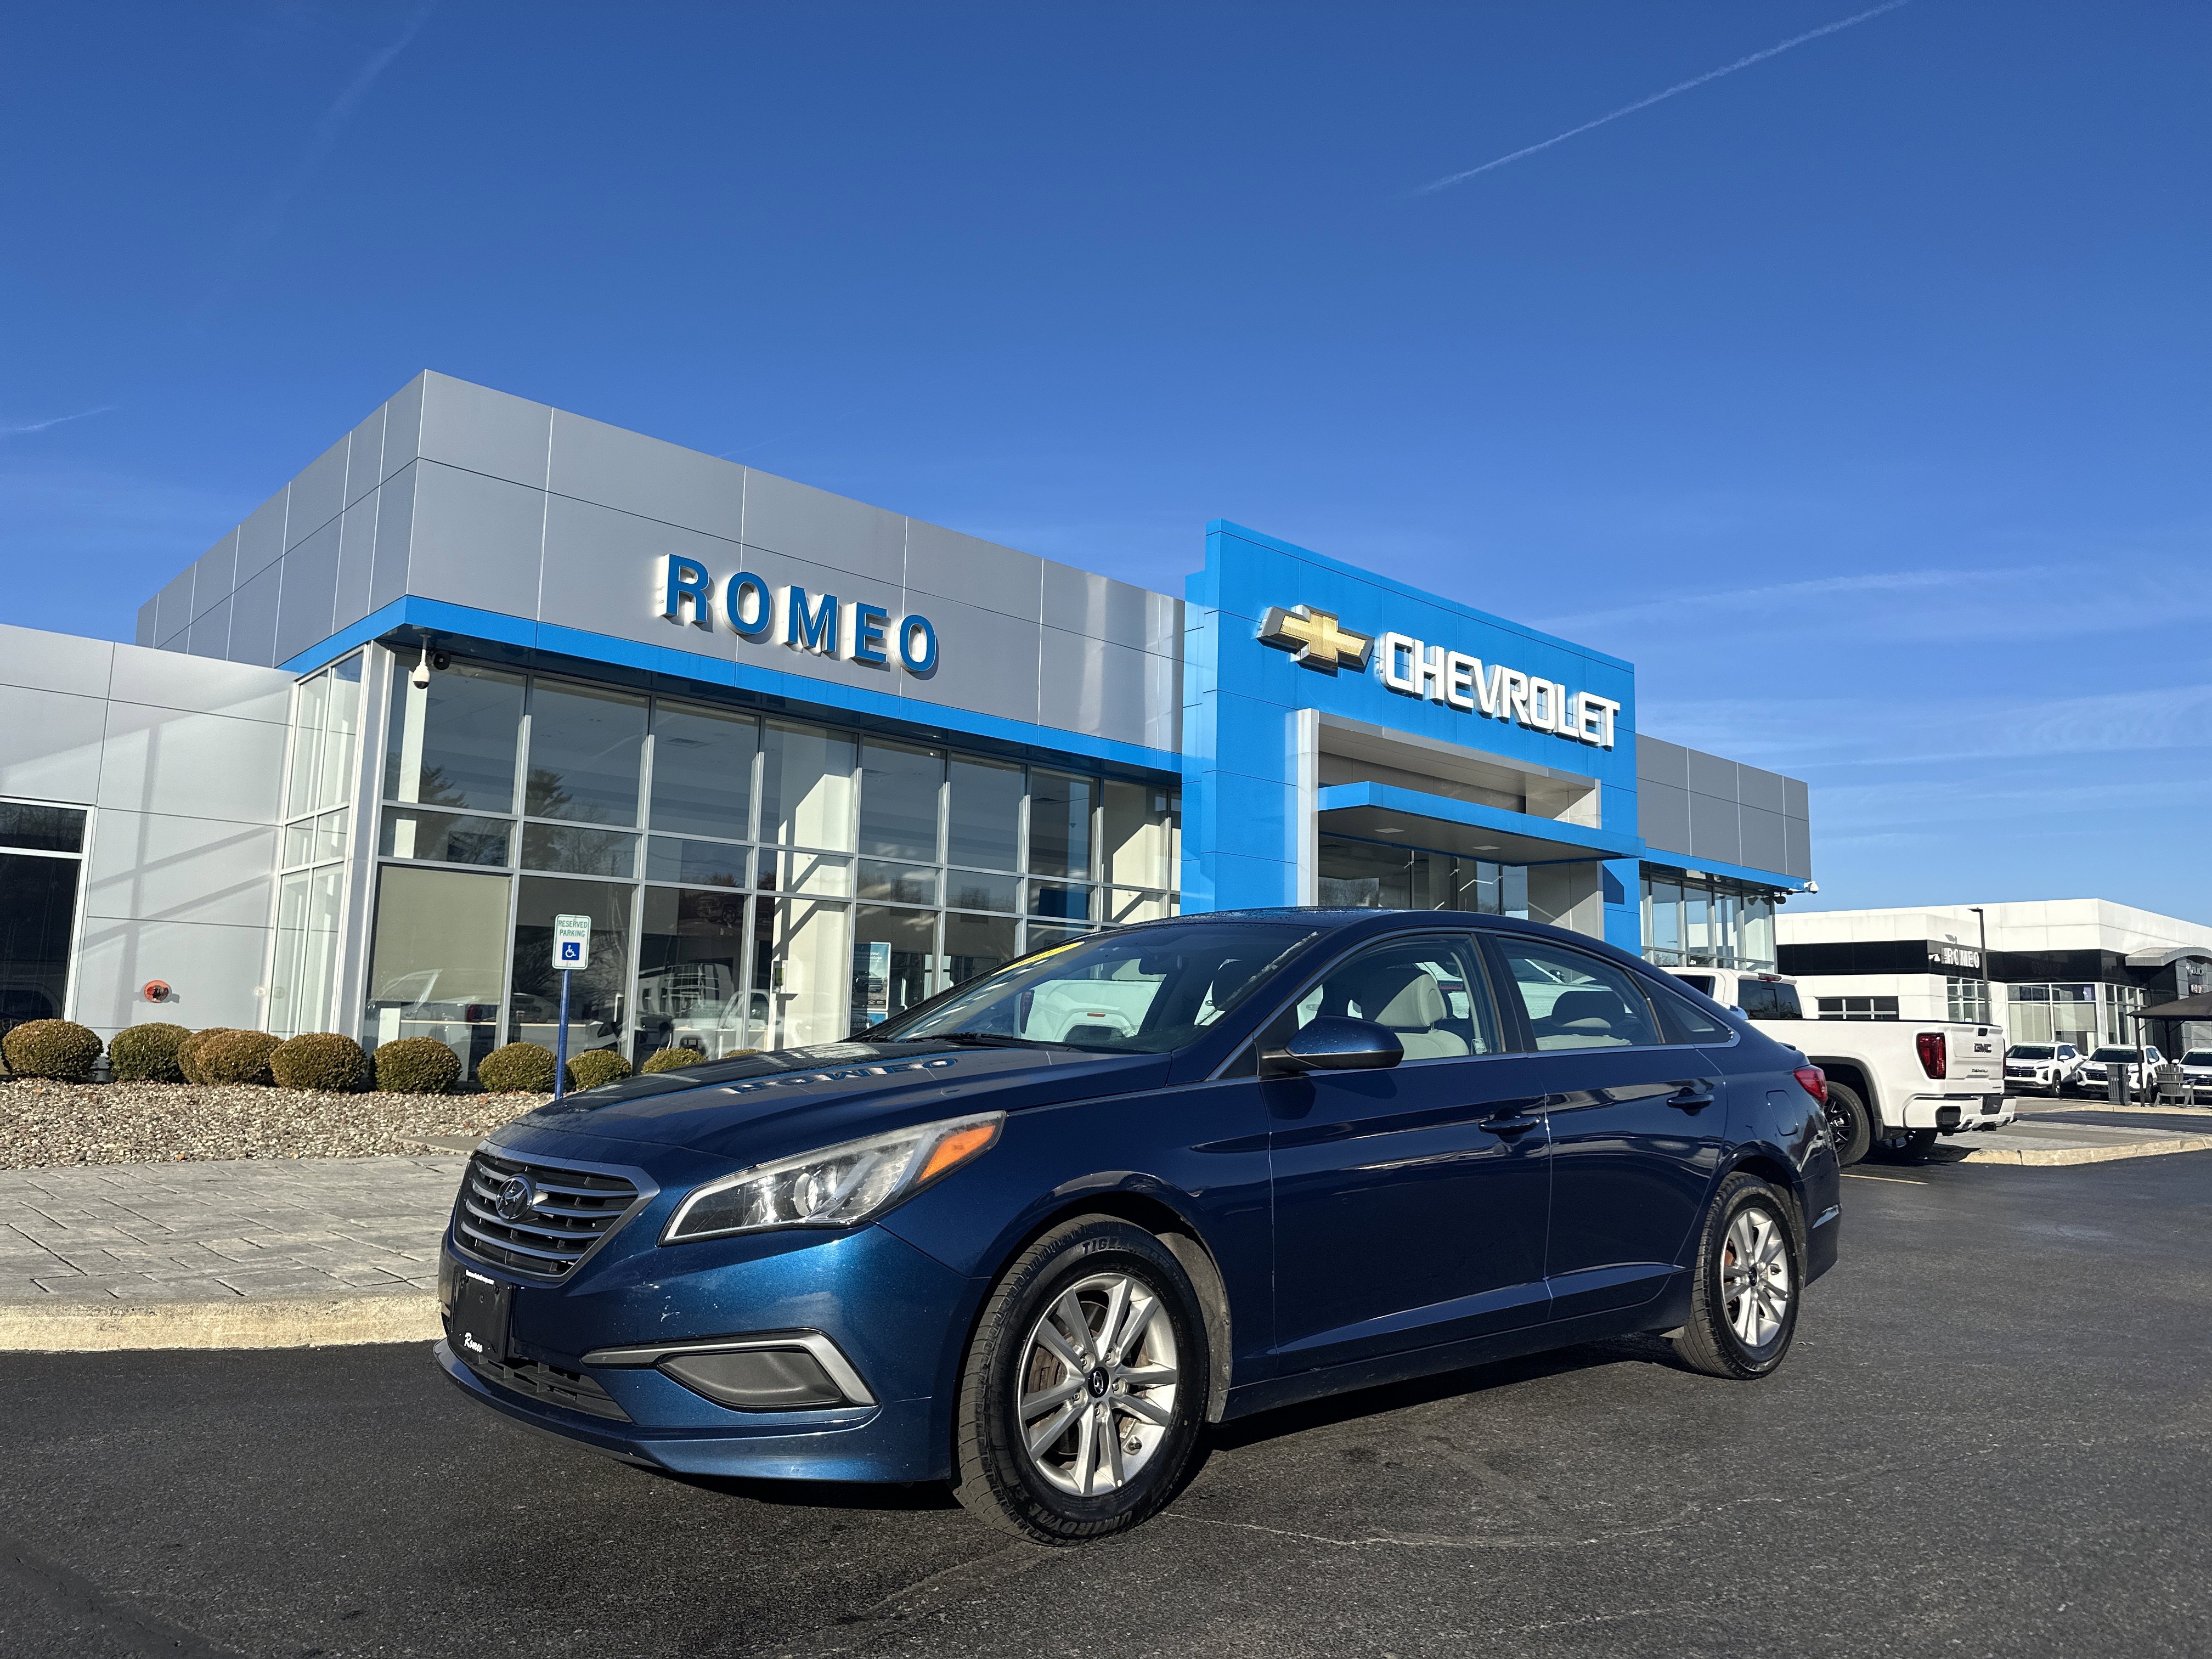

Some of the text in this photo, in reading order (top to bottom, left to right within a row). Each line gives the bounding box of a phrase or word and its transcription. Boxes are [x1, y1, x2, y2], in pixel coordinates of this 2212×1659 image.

[662, 554, 936, 672] ROMEO
[1381, 631, 1620, 747] CHEVROLET
[558, 920, 588, 928] RESERVED
[1943, 947, 1979, 968] ROMEO
[1974, 1043, 1991, 1053] GMC
[1029, 1503, 1133, 1535] UNIROYAL
